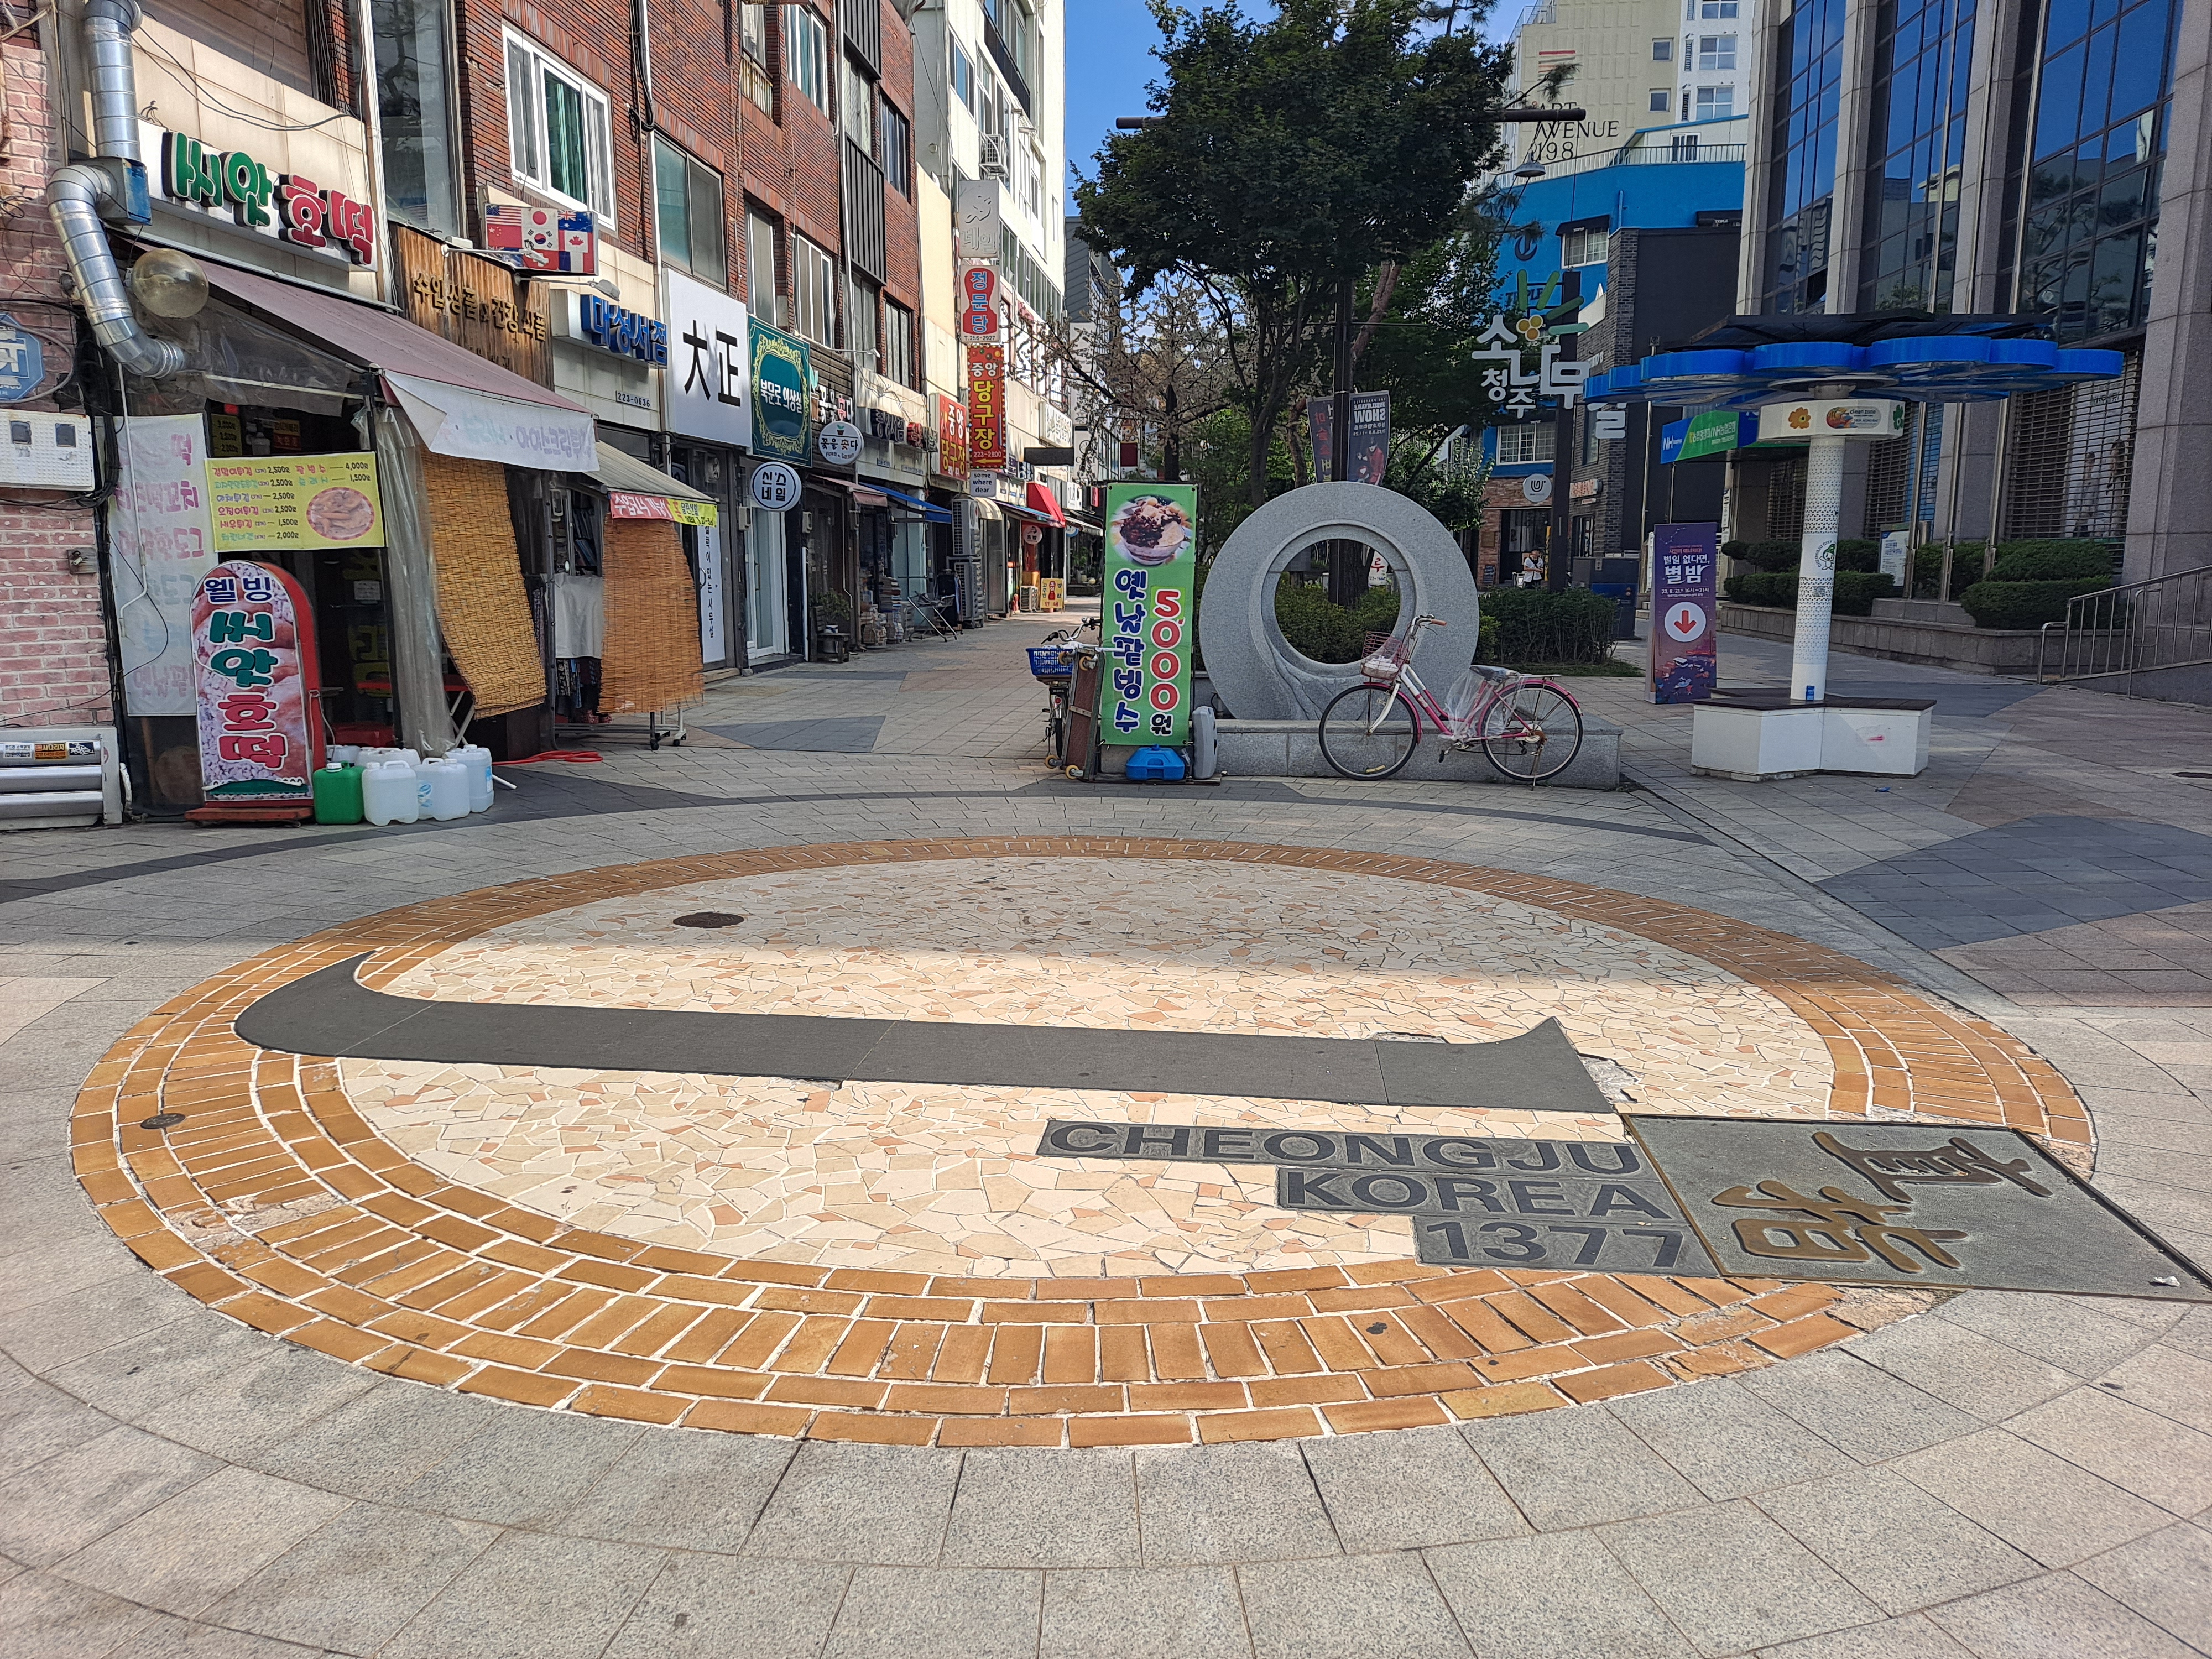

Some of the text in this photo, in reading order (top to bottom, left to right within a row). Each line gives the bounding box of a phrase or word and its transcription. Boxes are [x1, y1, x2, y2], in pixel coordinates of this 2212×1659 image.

[1535, 121, 1619, 139] AVENUE
[164, 131, 373, 265] 씨앗 호떡
[962, 227, 998, 255] 네일
[970, 271, 989, 333] 정문당
[586, 294, 667, 366] 대성서점
[683, 319, 741, 408] 大正
[971, 362, 998, 378] 중앙
[618, 392, 650, 408] 223-0636
[760, 378, 802, 414] 북문로 의상실
[1480, 368, 1536, 419] 청주
[948, 404, 964, 440] 중앙
[973, 380, 996, 450] 당구장
[821, 437, 838, 450] 꽃을
[941, 439, 966, 476] 당구장
[1663, 435, 1673, 451] NH
[218, 506, 259, 516] 오징어튀김
[761, 487, 786, 502] 네일
[1663, 554, 1710, 565] 별일 없다면,
[204, 577, 273, 603] 웰빙
[210, 610, 279, 689] 씨앗
[1113, 568, 1149, 734] 옛날팥빙수
[216, 692, 289, 770] 호떡
[1049, 1123, 1641, 1176] CHEONGJU
[1286, 1171, 1674, 1220] KOREA
[1425, 1221, 1684, 1269] 1377
